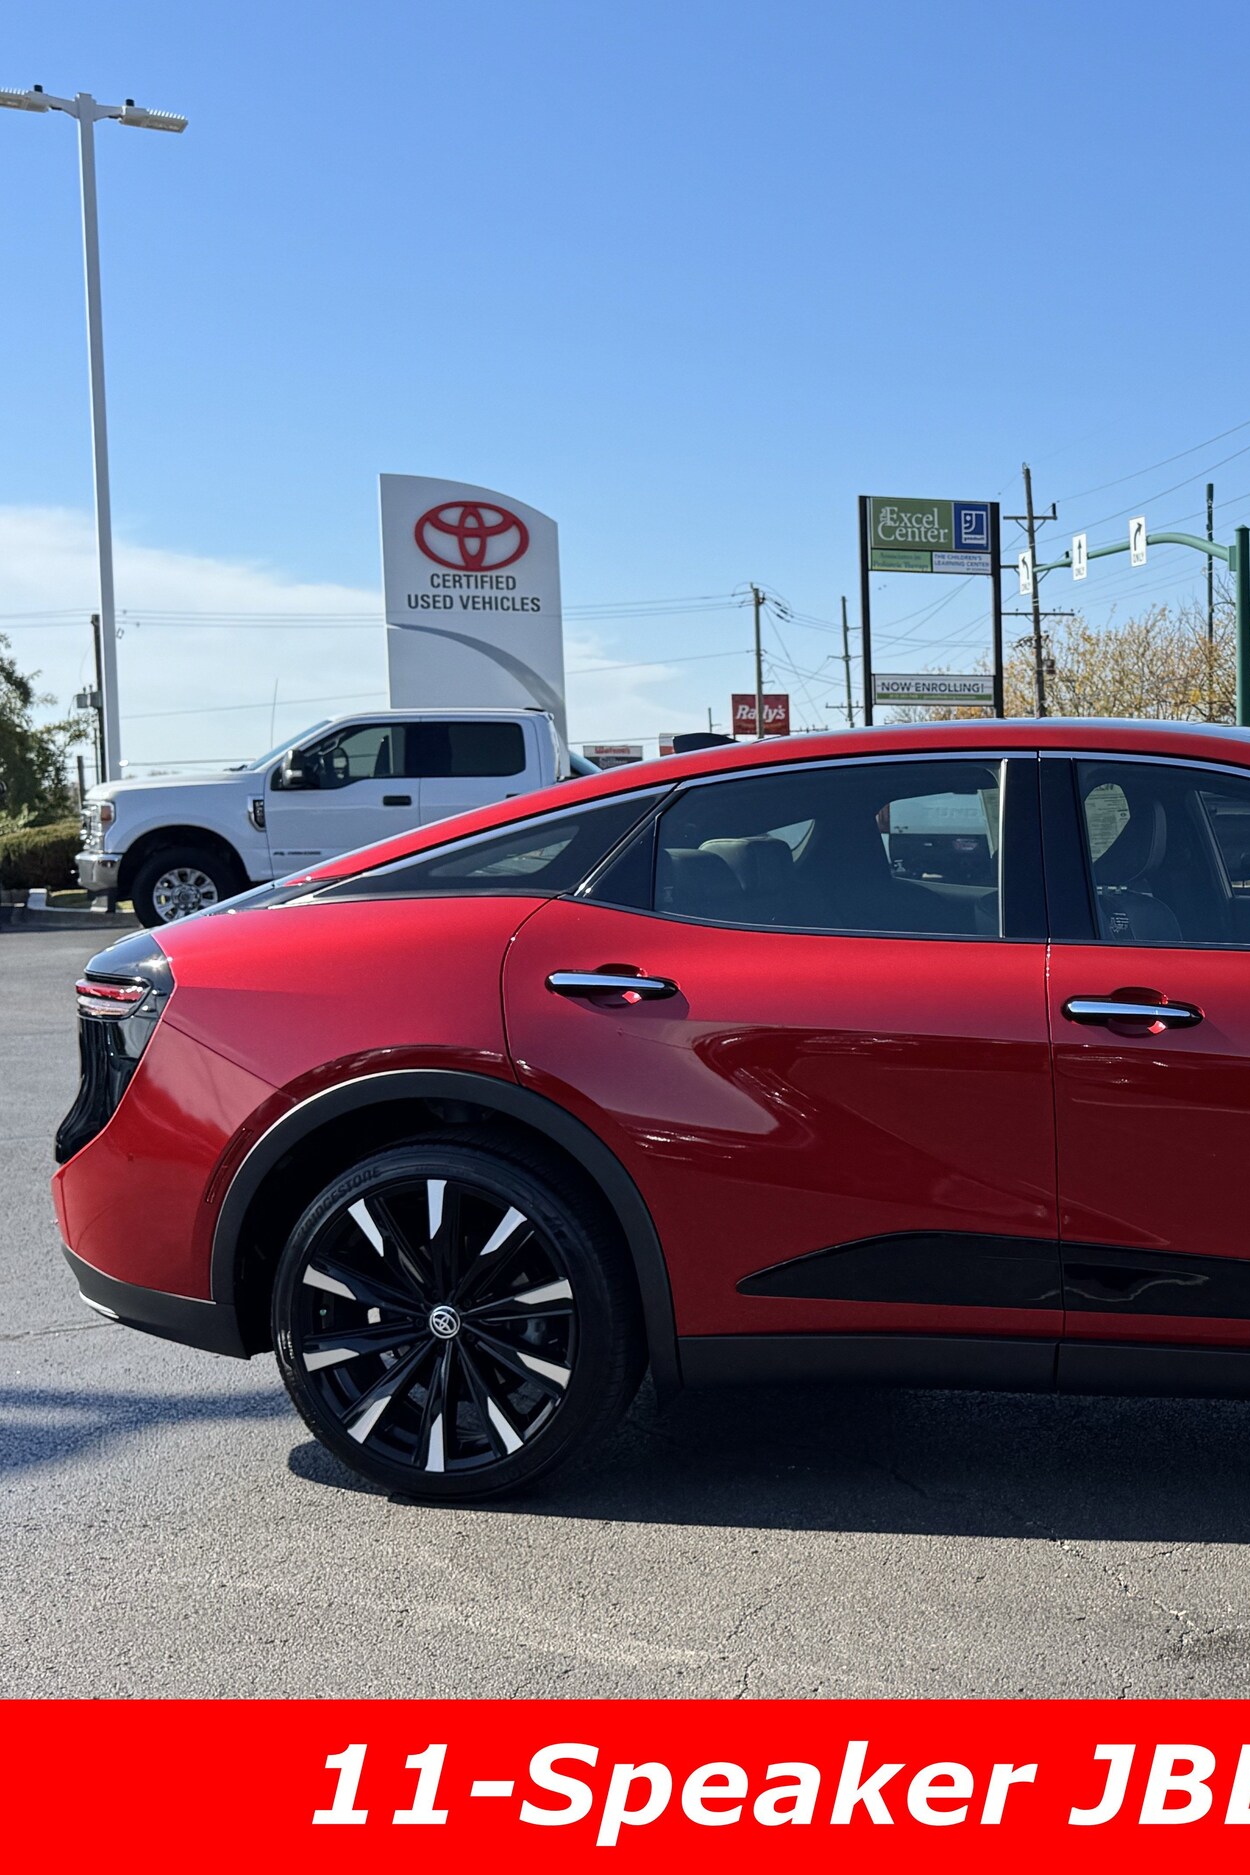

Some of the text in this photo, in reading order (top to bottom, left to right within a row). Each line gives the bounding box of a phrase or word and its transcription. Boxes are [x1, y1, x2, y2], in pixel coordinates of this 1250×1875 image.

[885, 506, 939, 528] Excel
[878, 520, 948, 543] Center
[430, 573, 517, 591] CERTIFIED
[407, 594, 541, 612] USED VEHICLES
[881, 682, 984, 693] NOW ENROLLING!
[736, 705, 786, 722] Raly's
